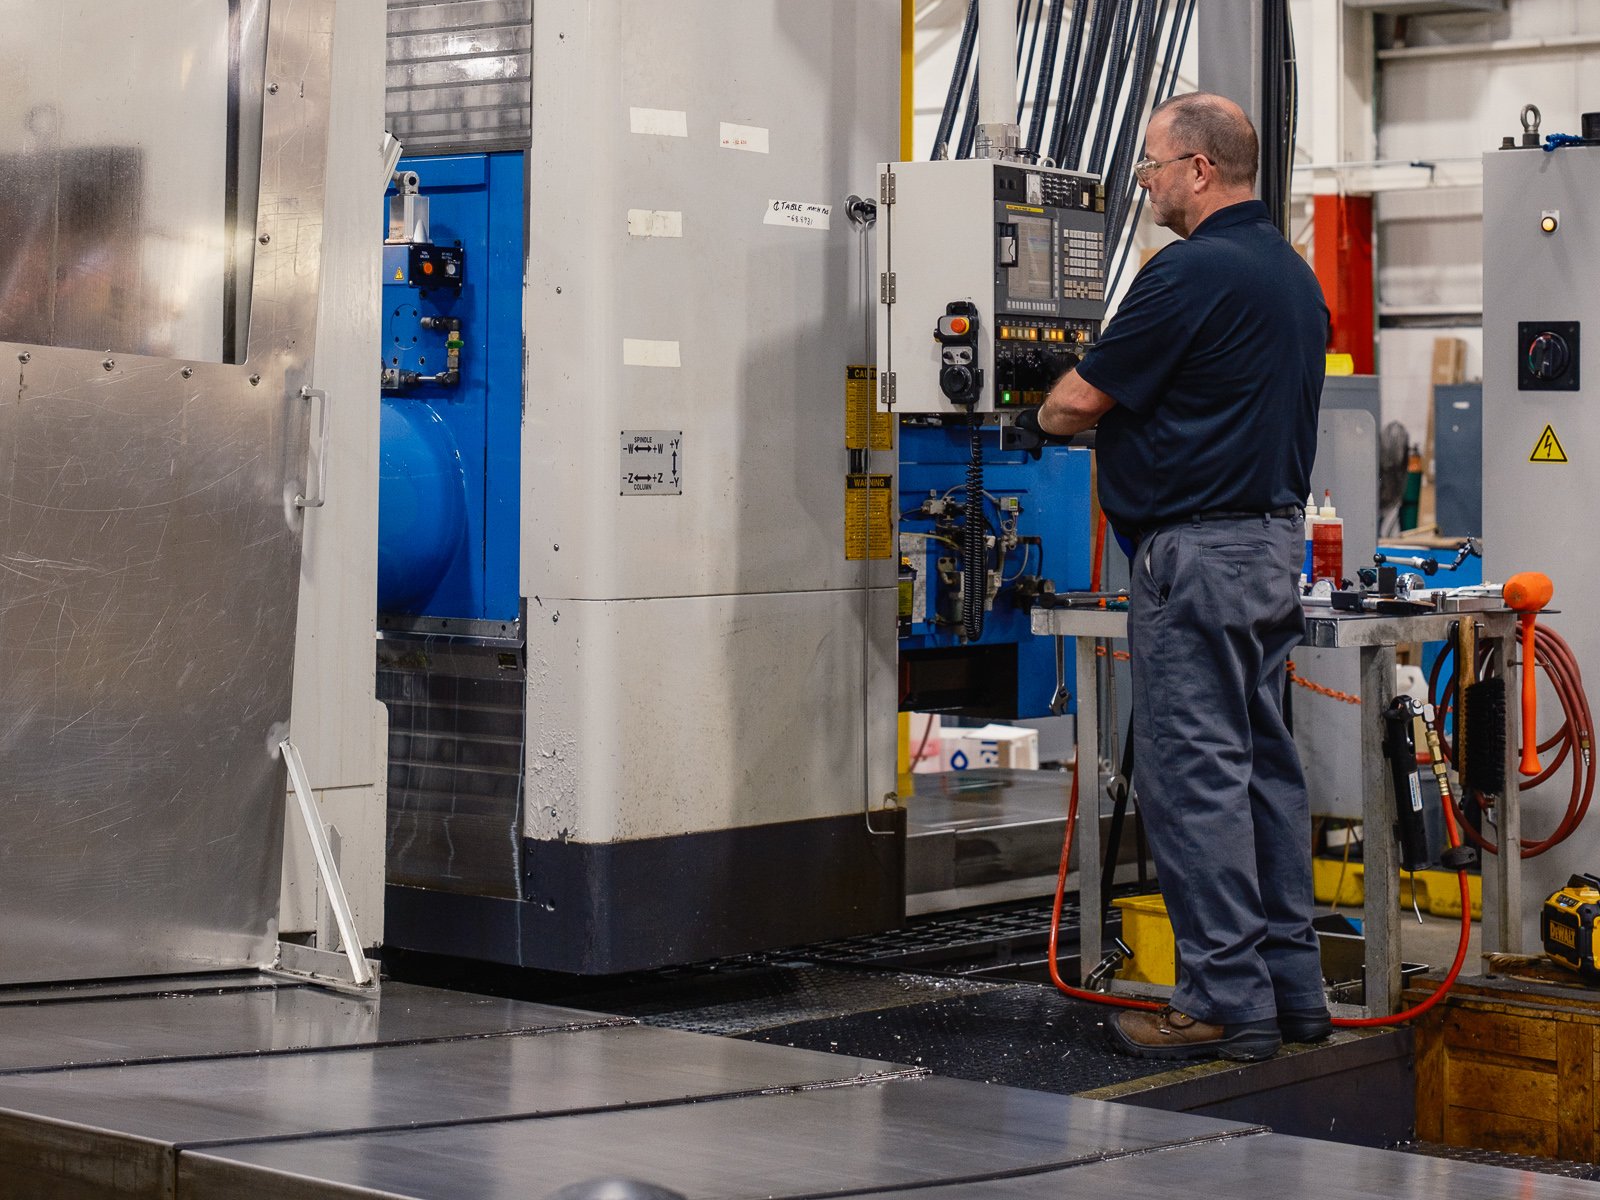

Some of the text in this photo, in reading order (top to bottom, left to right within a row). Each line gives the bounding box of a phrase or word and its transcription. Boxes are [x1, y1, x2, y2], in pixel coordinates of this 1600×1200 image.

[781, 202, 803, 212] TABLE
[623, 444, 663, 454] -W +W
[670, 439, 679, 449] +Y
[623, 473, 663, 483] -Z +Z
[670, 477, 679, 487] -Y
